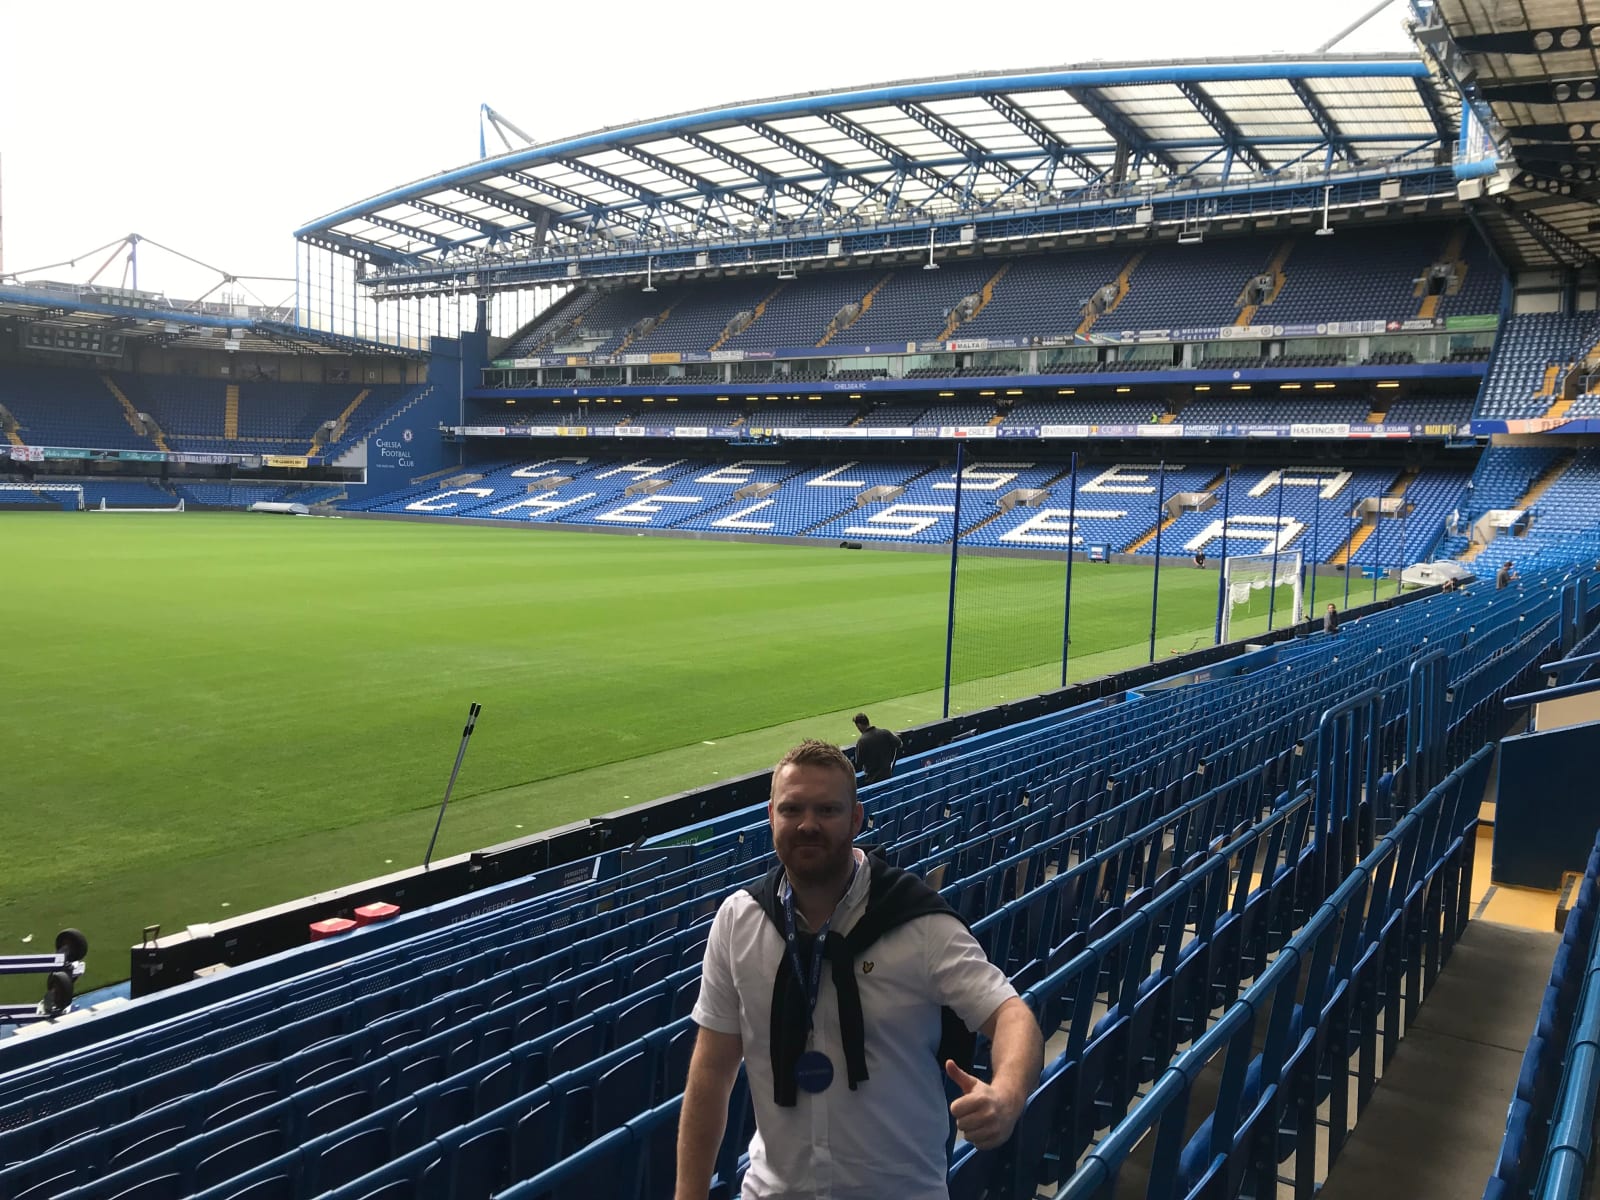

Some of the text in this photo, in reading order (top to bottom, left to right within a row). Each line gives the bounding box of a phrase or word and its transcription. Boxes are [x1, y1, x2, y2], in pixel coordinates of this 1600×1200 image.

[1101, 425, 1123, 434] CORK
[1293, 426, 1335, 435] HASTINGS
[376, 438, 402, 449] CHELSEA
[381, 447, 411, 458] FOOTBALL
[398, 458, 415, 467] CLUB
[511, 455, 1353, 501] CHELSEA
[404, 487, 1306, 553] CHELSEA
[482, 900, 514, 915] OFFENCE
